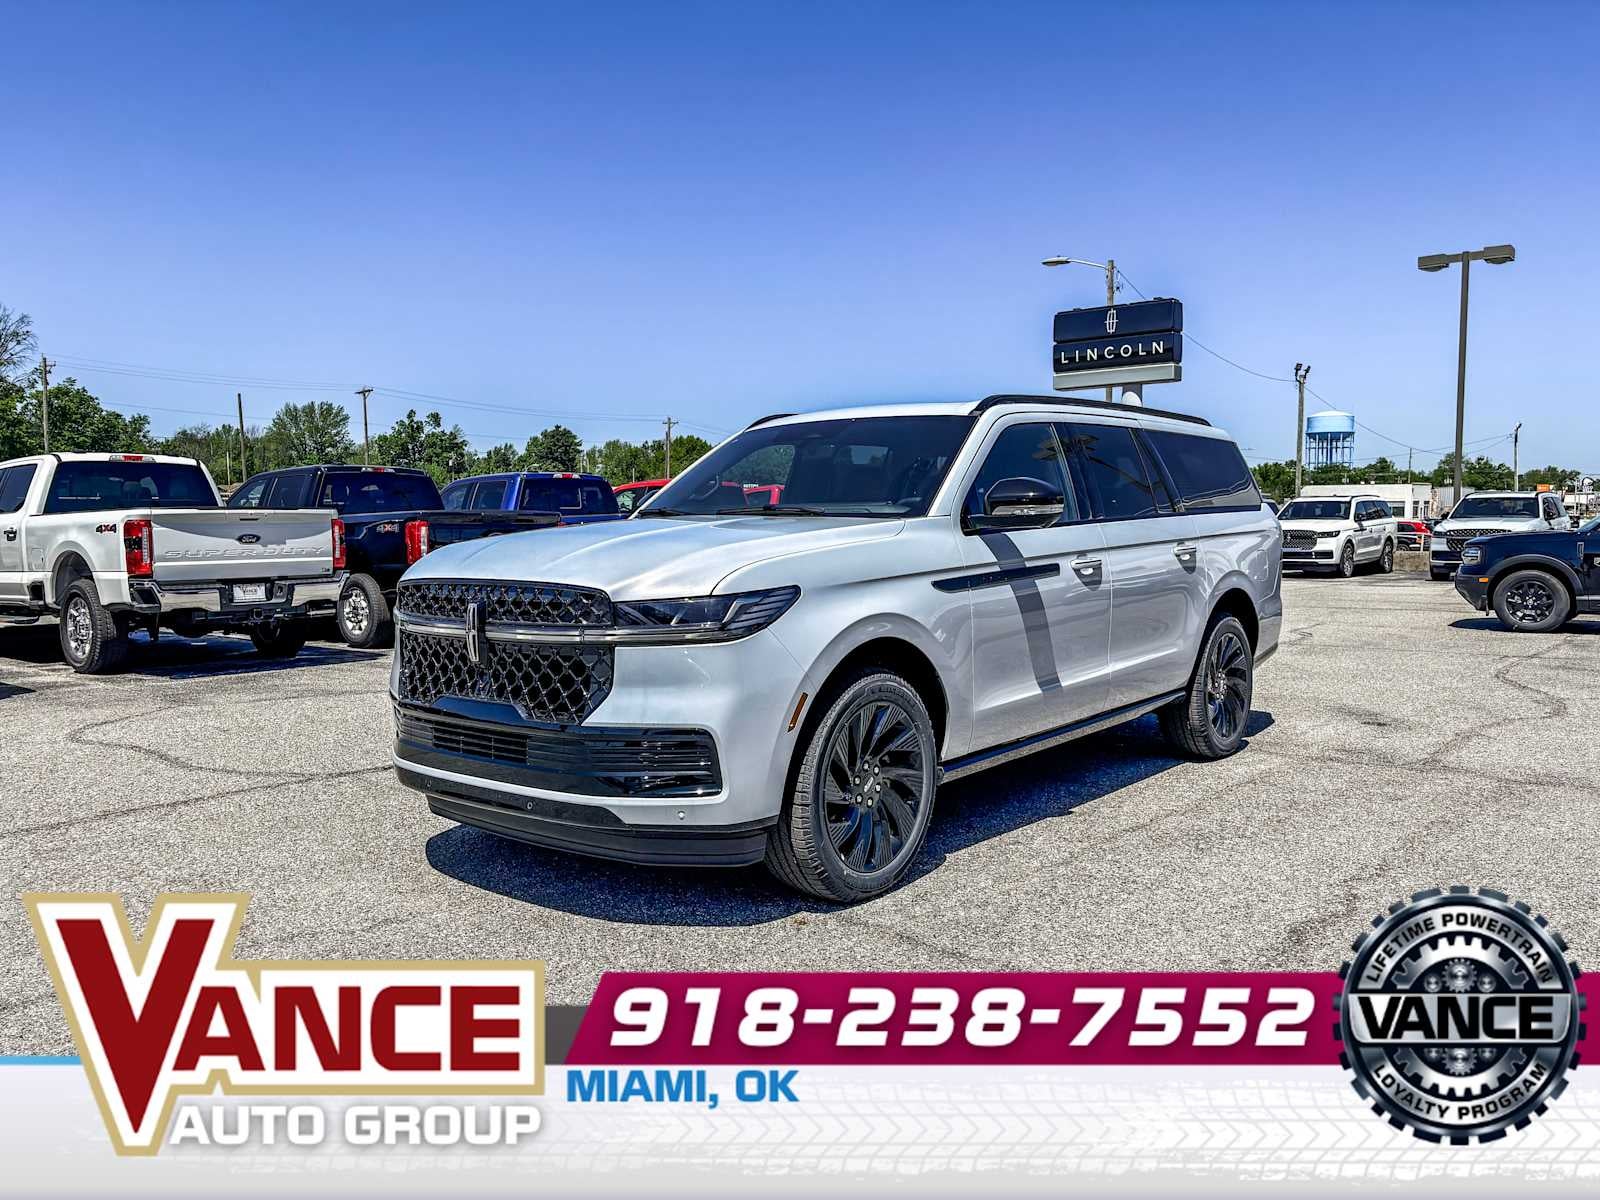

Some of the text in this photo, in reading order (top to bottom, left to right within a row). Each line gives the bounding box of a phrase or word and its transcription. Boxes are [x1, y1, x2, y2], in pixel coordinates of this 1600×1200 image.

[1060, 340, 1164, 365] LINCOLN
[164, 545, 325, 559] SUPER DUTY
